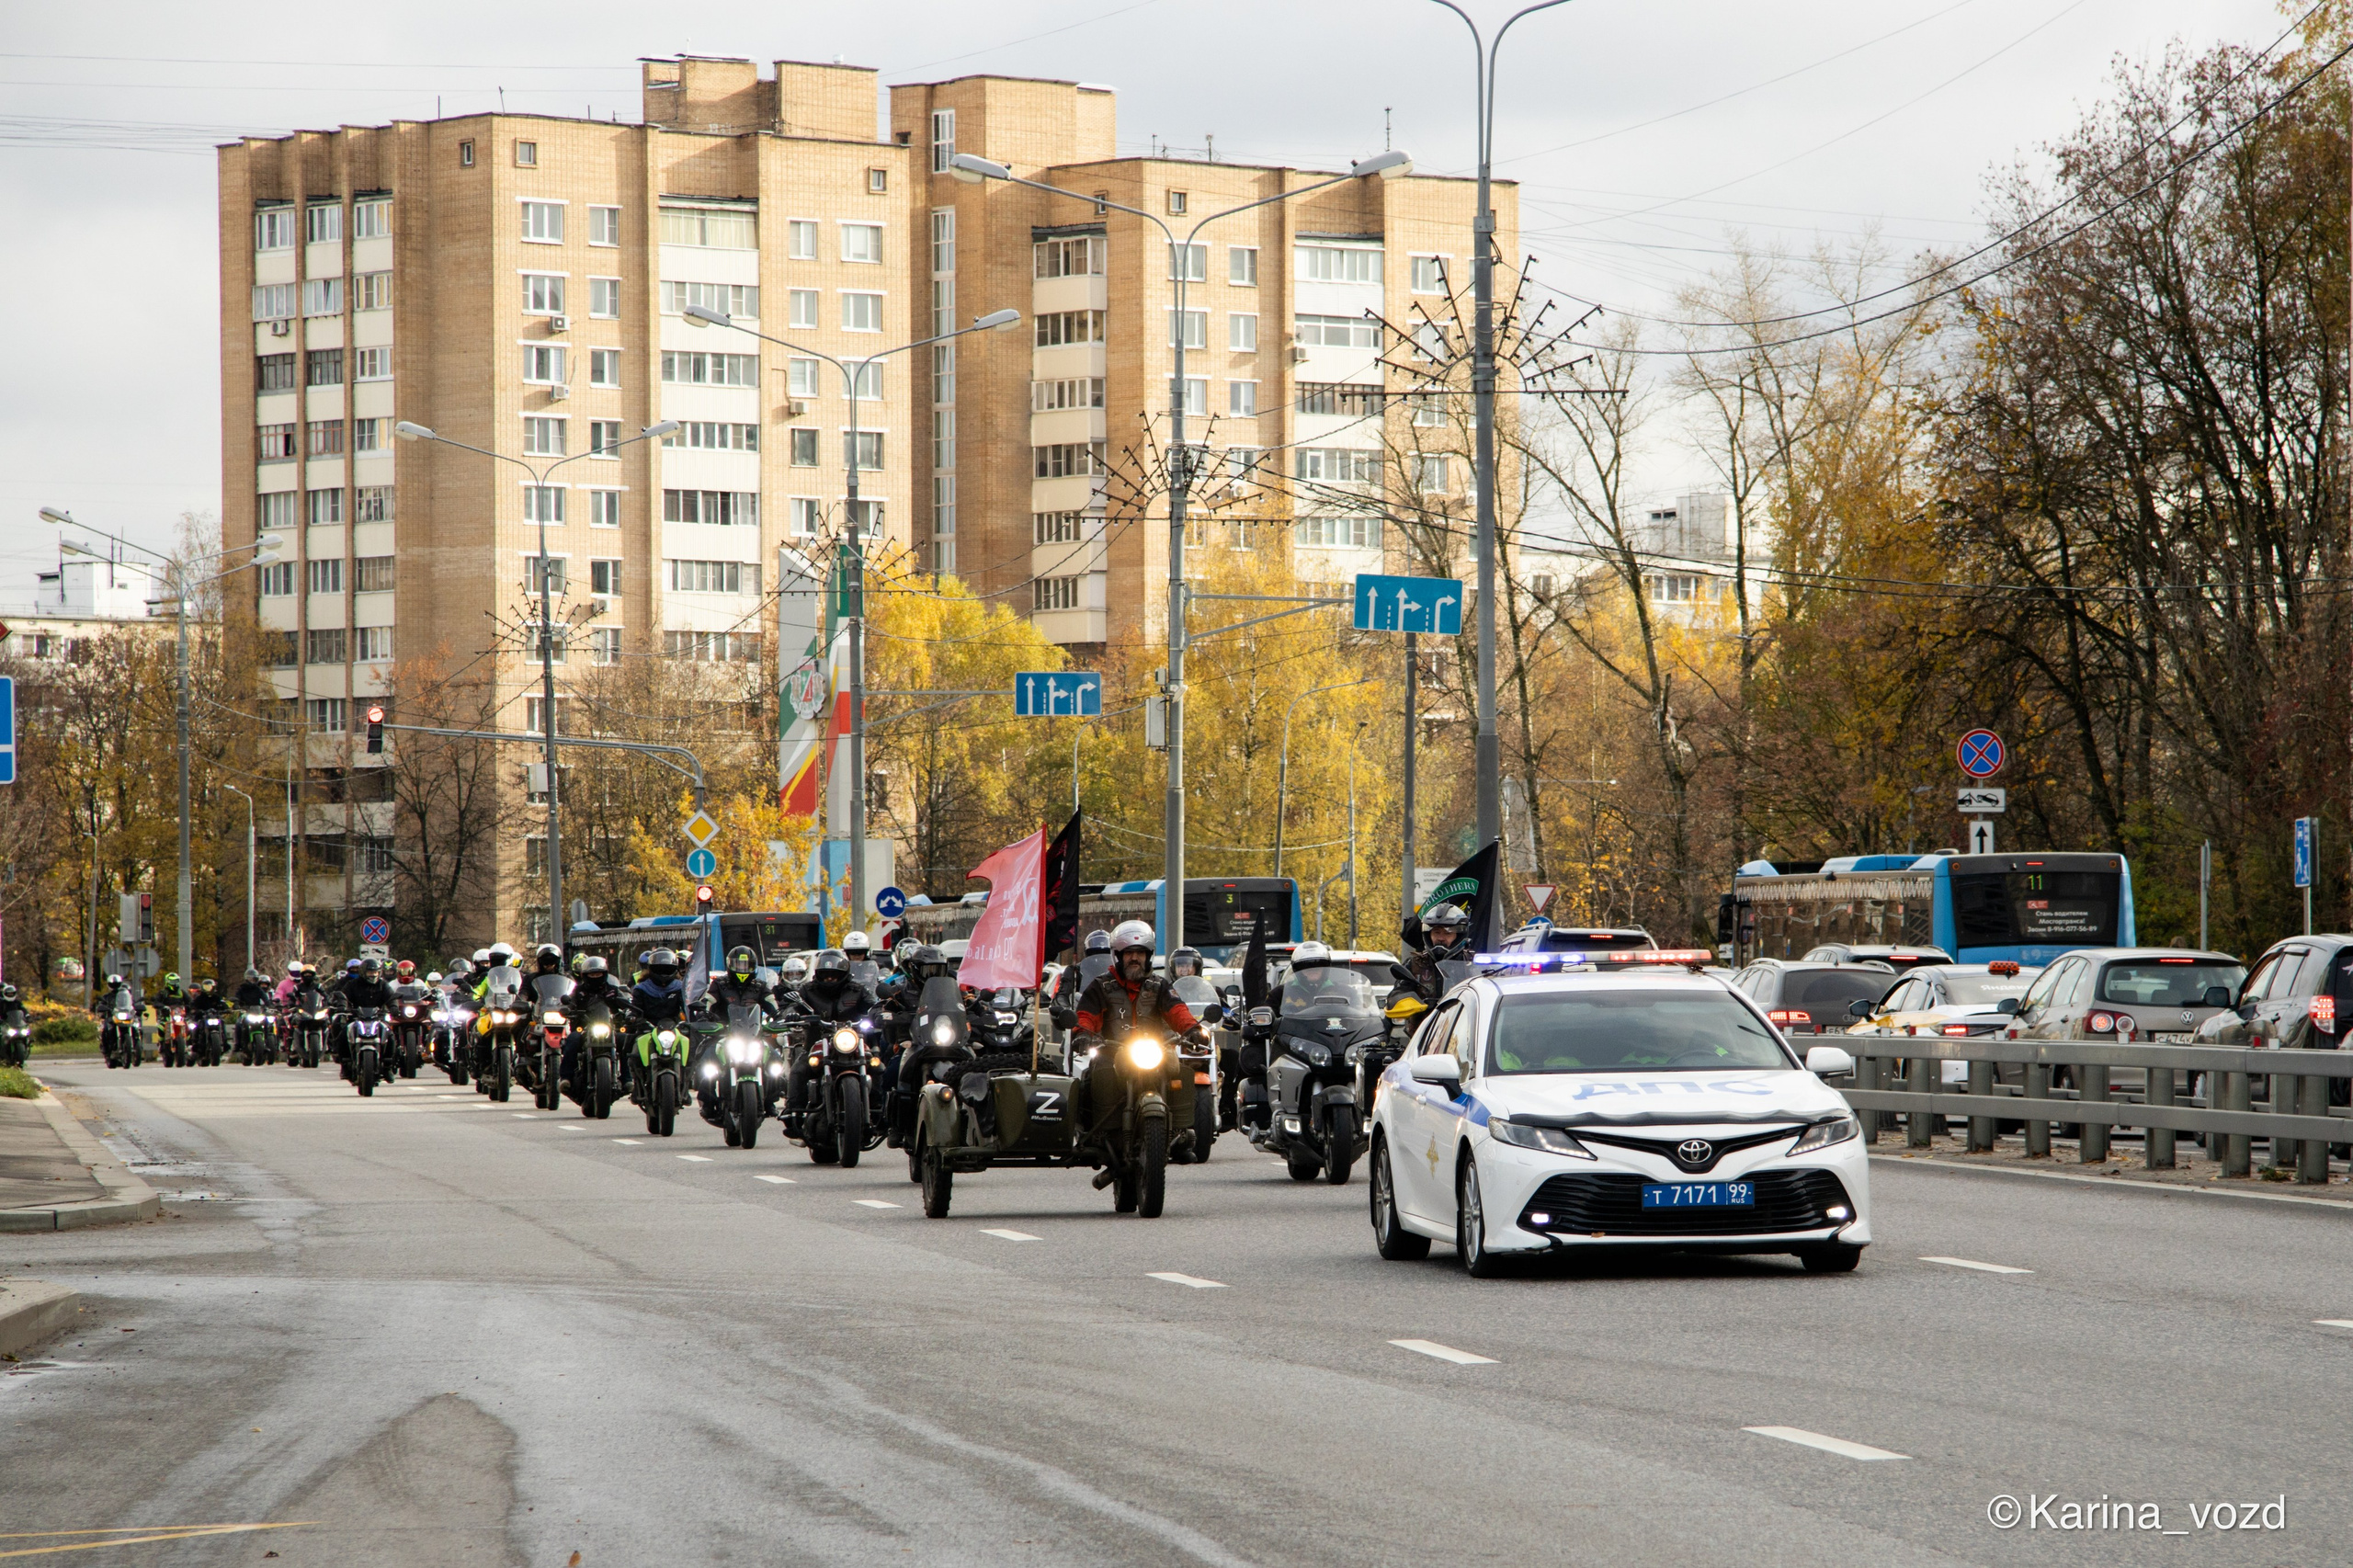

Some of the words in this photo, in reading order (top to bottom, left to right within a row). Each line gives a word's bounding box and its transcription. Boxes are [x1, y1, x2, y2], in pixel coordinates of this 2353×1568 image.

[2029, 874, 2042, 891] 11
[1226, 893, 1233, 903] 3
[1426, 881, 1475, 906] BROTHERS
[765, 925, 775, 935] 31
[1572, 1081, 1774, 1101] ДПС
[1035, 1091, 1061, 1114] Z
[1671, 1186, 1717, 1204] 7171
[1729, 1184, 1747, 1198] 99
